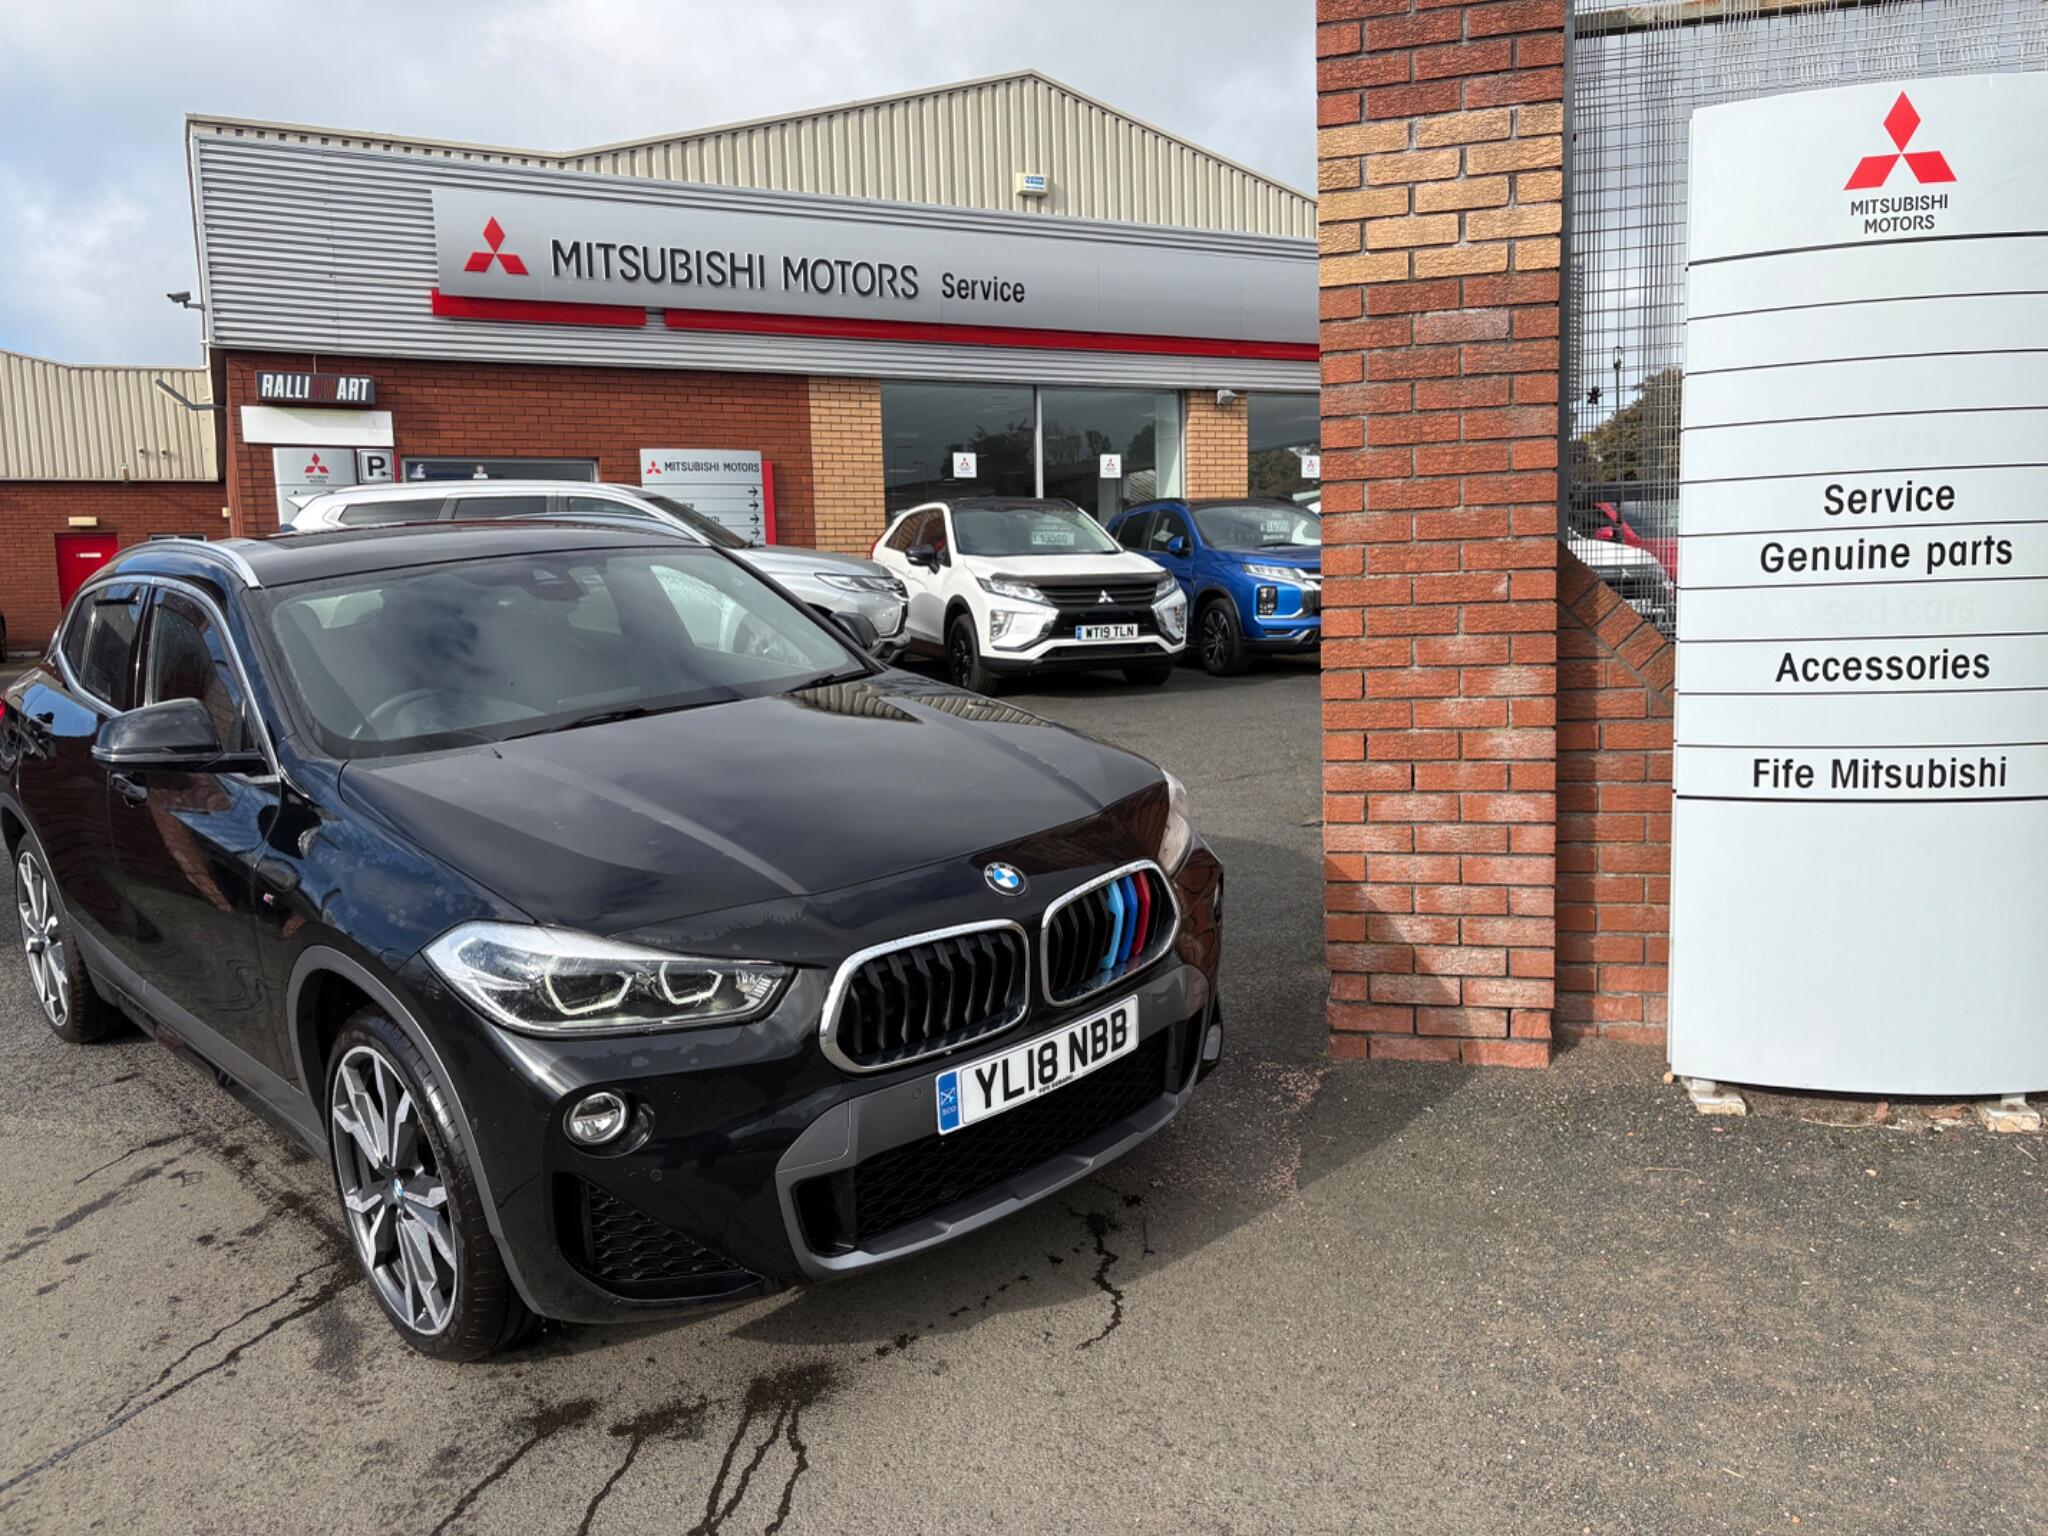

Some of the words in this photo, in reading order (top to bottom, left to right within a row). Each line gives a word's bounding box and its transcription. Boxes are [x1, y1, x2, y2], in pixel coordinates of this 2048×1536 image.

[1850, 193, 1949, 217] MITSUBISHI
[1863, 213, 1936, 235] MOTORS
[550, 238, 765, 290] MITSUBISHI
[781, 255, 920, 301] MOTORS
[940, 271, 1027, 304] Service
[367, 456, 386, 477] P
[664, 461, 720, 472] MITSUBISHI
[723, 462, 760, 473] MOTORS
[1822, 480, 1956, 516] Service
[1759, 537, 1911, 574] Genuine
[1925, 534, 2014, 575] parts
[1086, 627, 1110, 638] WT19
[1113, 625, 1134, 637] TLN
[1774, 647, 1991, 684] Accessories
[1752, 757, 1815, 789] Fife
[1830, 756, 2008, 790] Mitsubishi
[975, 1040, 1059, 1110] YL18
[1068, 1008, 1128, 1073] NBB
